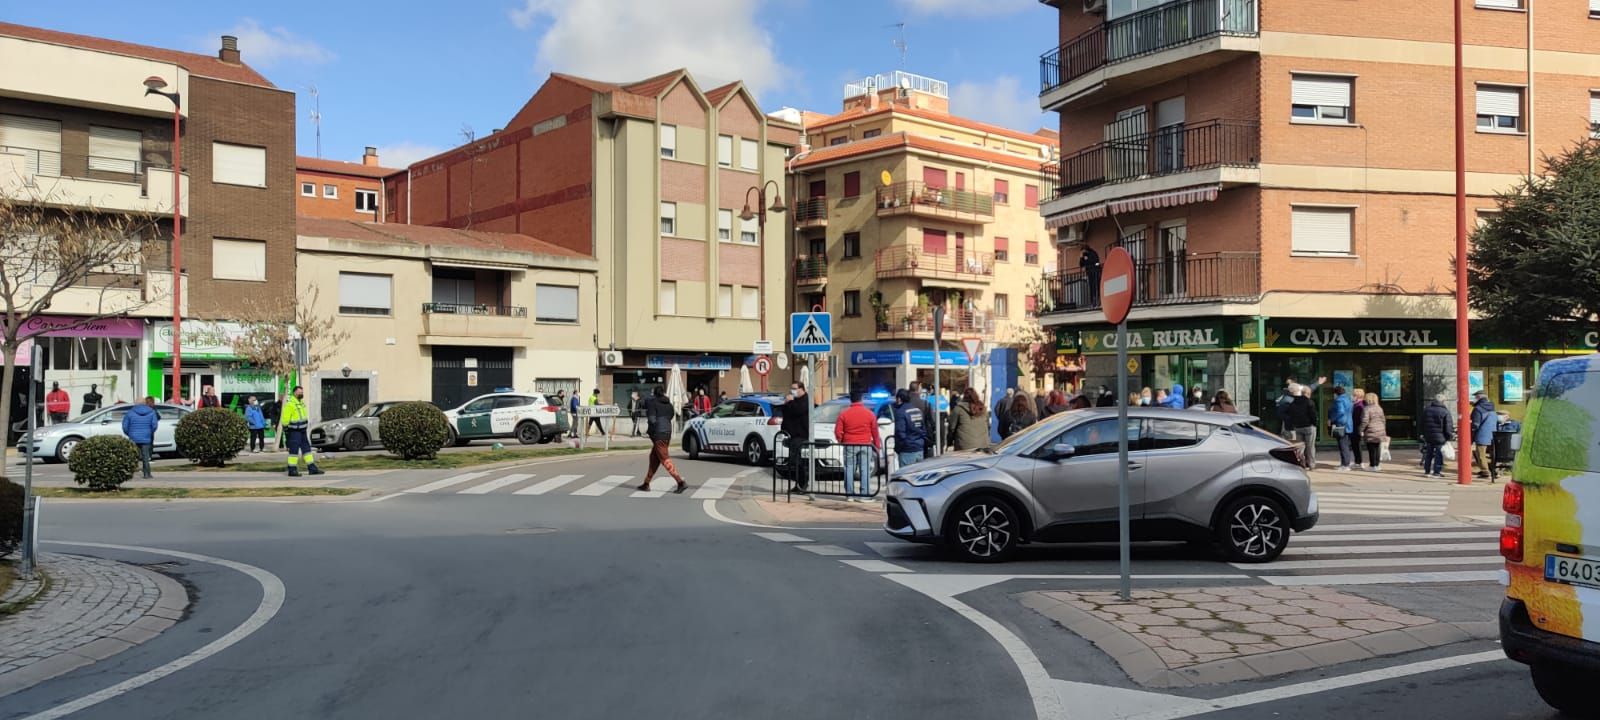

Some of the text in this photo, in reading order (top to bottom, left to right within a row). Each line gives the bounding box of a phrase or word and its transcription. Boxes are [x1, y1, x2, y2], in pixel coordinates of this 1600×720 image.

[1153, 329, 1218, 347] RURAL
[1290, 329, 1438, 347] CAJA RURAL
